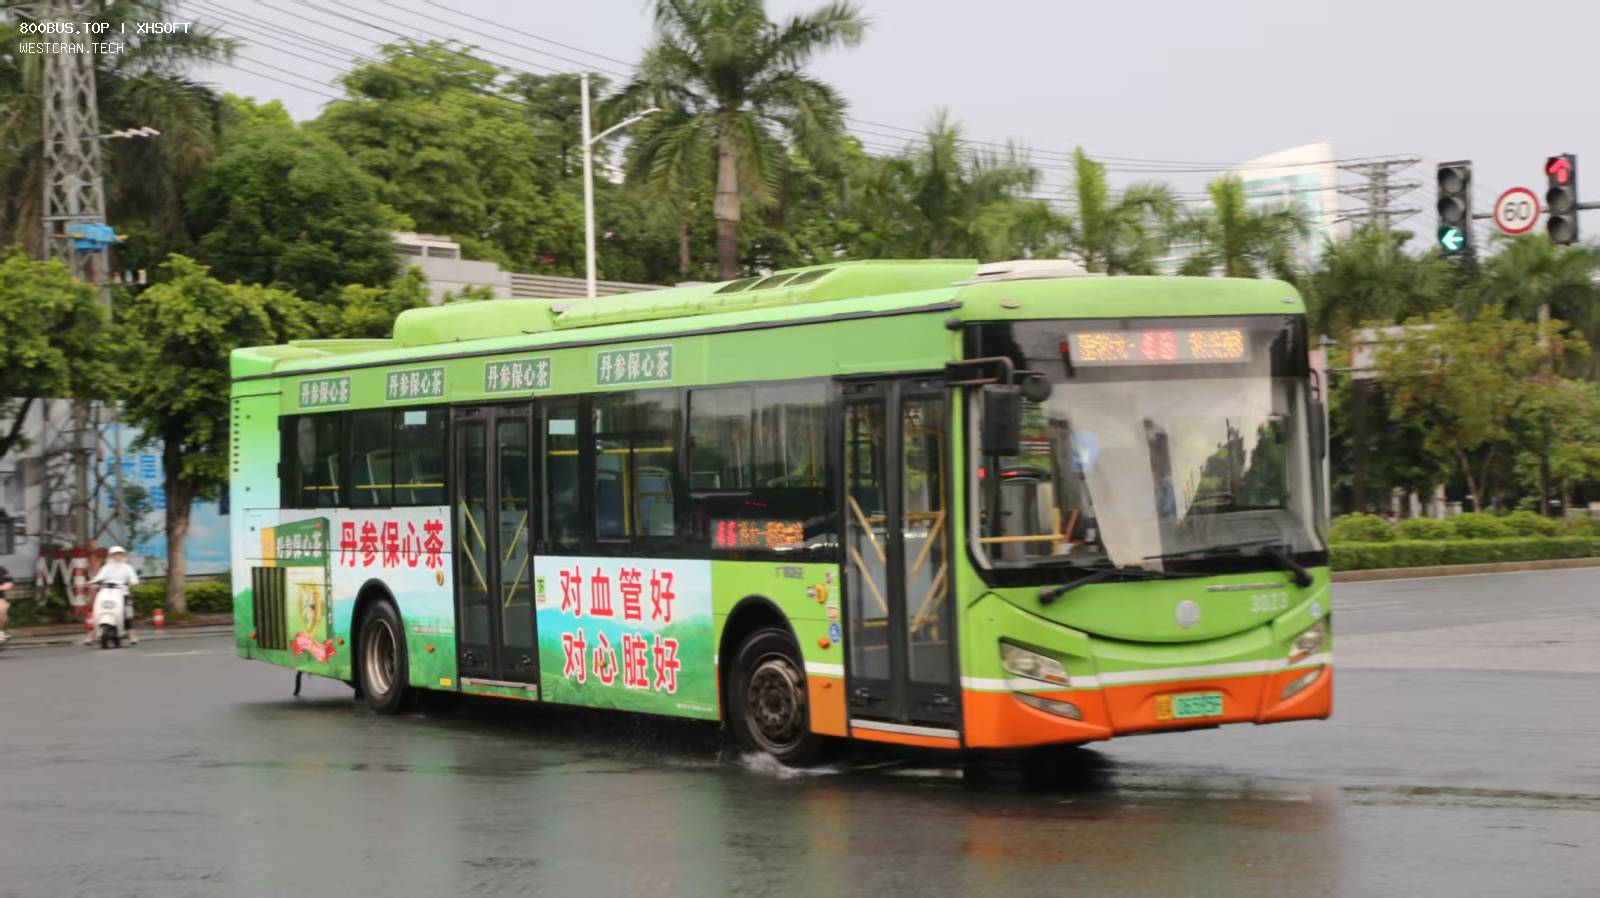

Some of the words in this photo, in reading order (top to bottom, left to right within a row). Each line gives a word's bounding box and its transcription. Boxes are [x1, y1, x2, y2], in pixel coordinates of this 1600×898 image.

[1504, 201, 1530, 221] 60
[487, 360, 548, 390] 丹参保心茶
[599, 350, 669, 380] 丹参保心茶
[388, 370, 442, 397] 丹参保心茶
[340, 519, 445, 569] 丹参保心茶
[559, 565, 676, 623] 对血管好
[562, 629, 681, 693] 对心脏好
